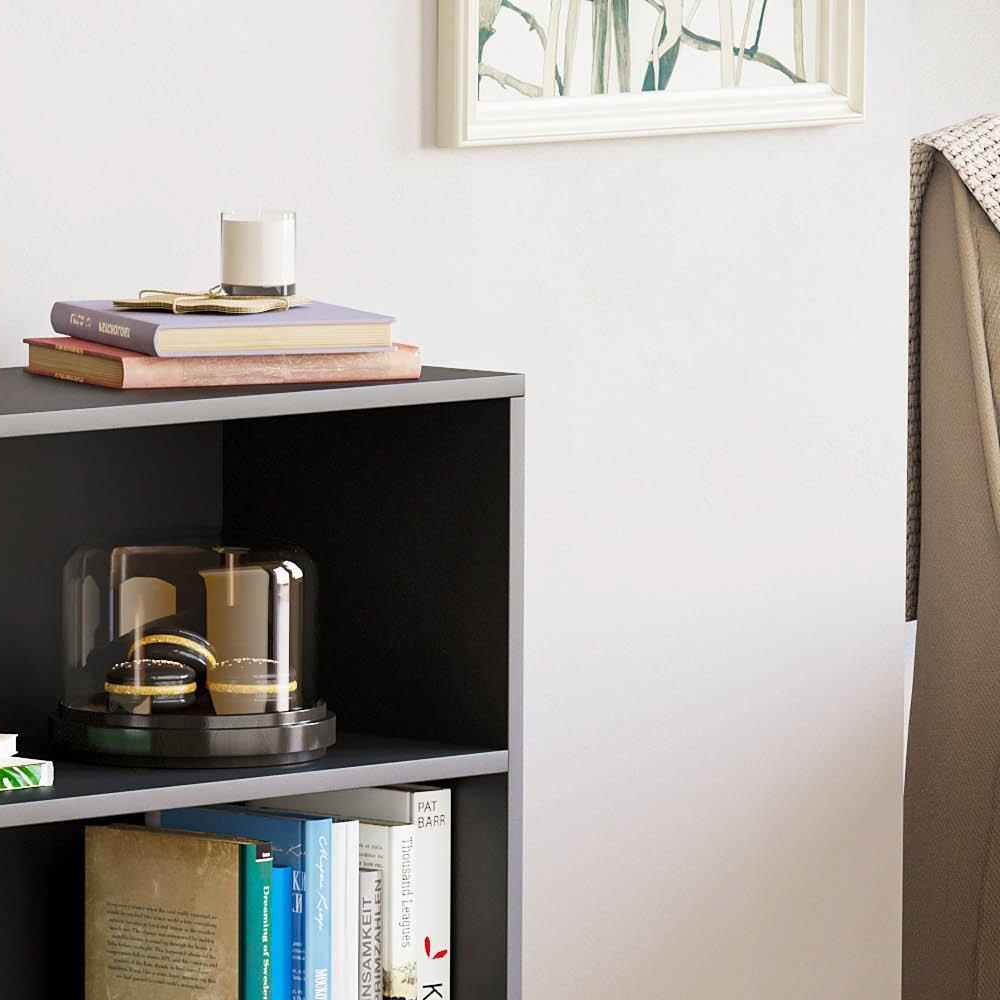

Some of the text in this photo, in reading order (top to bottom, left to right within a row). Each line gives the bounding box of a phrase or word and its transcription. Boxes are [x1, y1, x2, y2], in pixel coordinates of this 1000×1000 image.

[417, 801, 438, 813] PAT
[417, 814, 446, 829] BARR
[400, 836, 413, 949] Thousand Leagues
[261, 885, 270, 942] Dreaming
[262, 943, 270, 957] of
